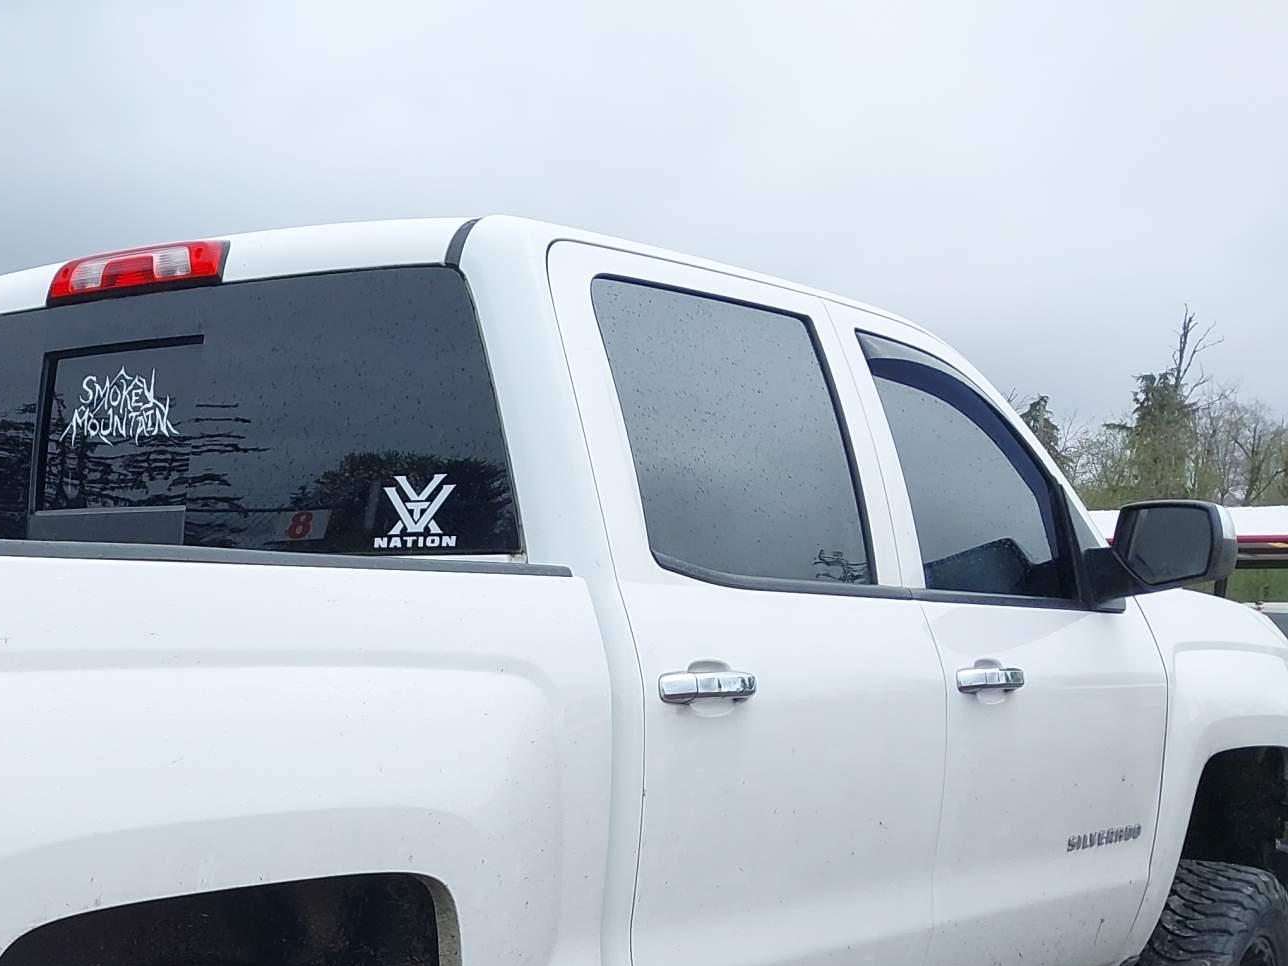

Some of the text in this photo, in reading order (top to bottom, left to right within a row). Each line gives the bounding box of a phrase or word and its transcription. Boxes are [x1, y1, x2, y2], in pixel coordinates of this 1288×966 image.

[79, 365, 155, 413] SMOKEY
[59, 396, 179, 447] MOUNTAIN
[373, 536, 456, 548] NATION
[1066, 824, 1141, 852] SILVERADO
